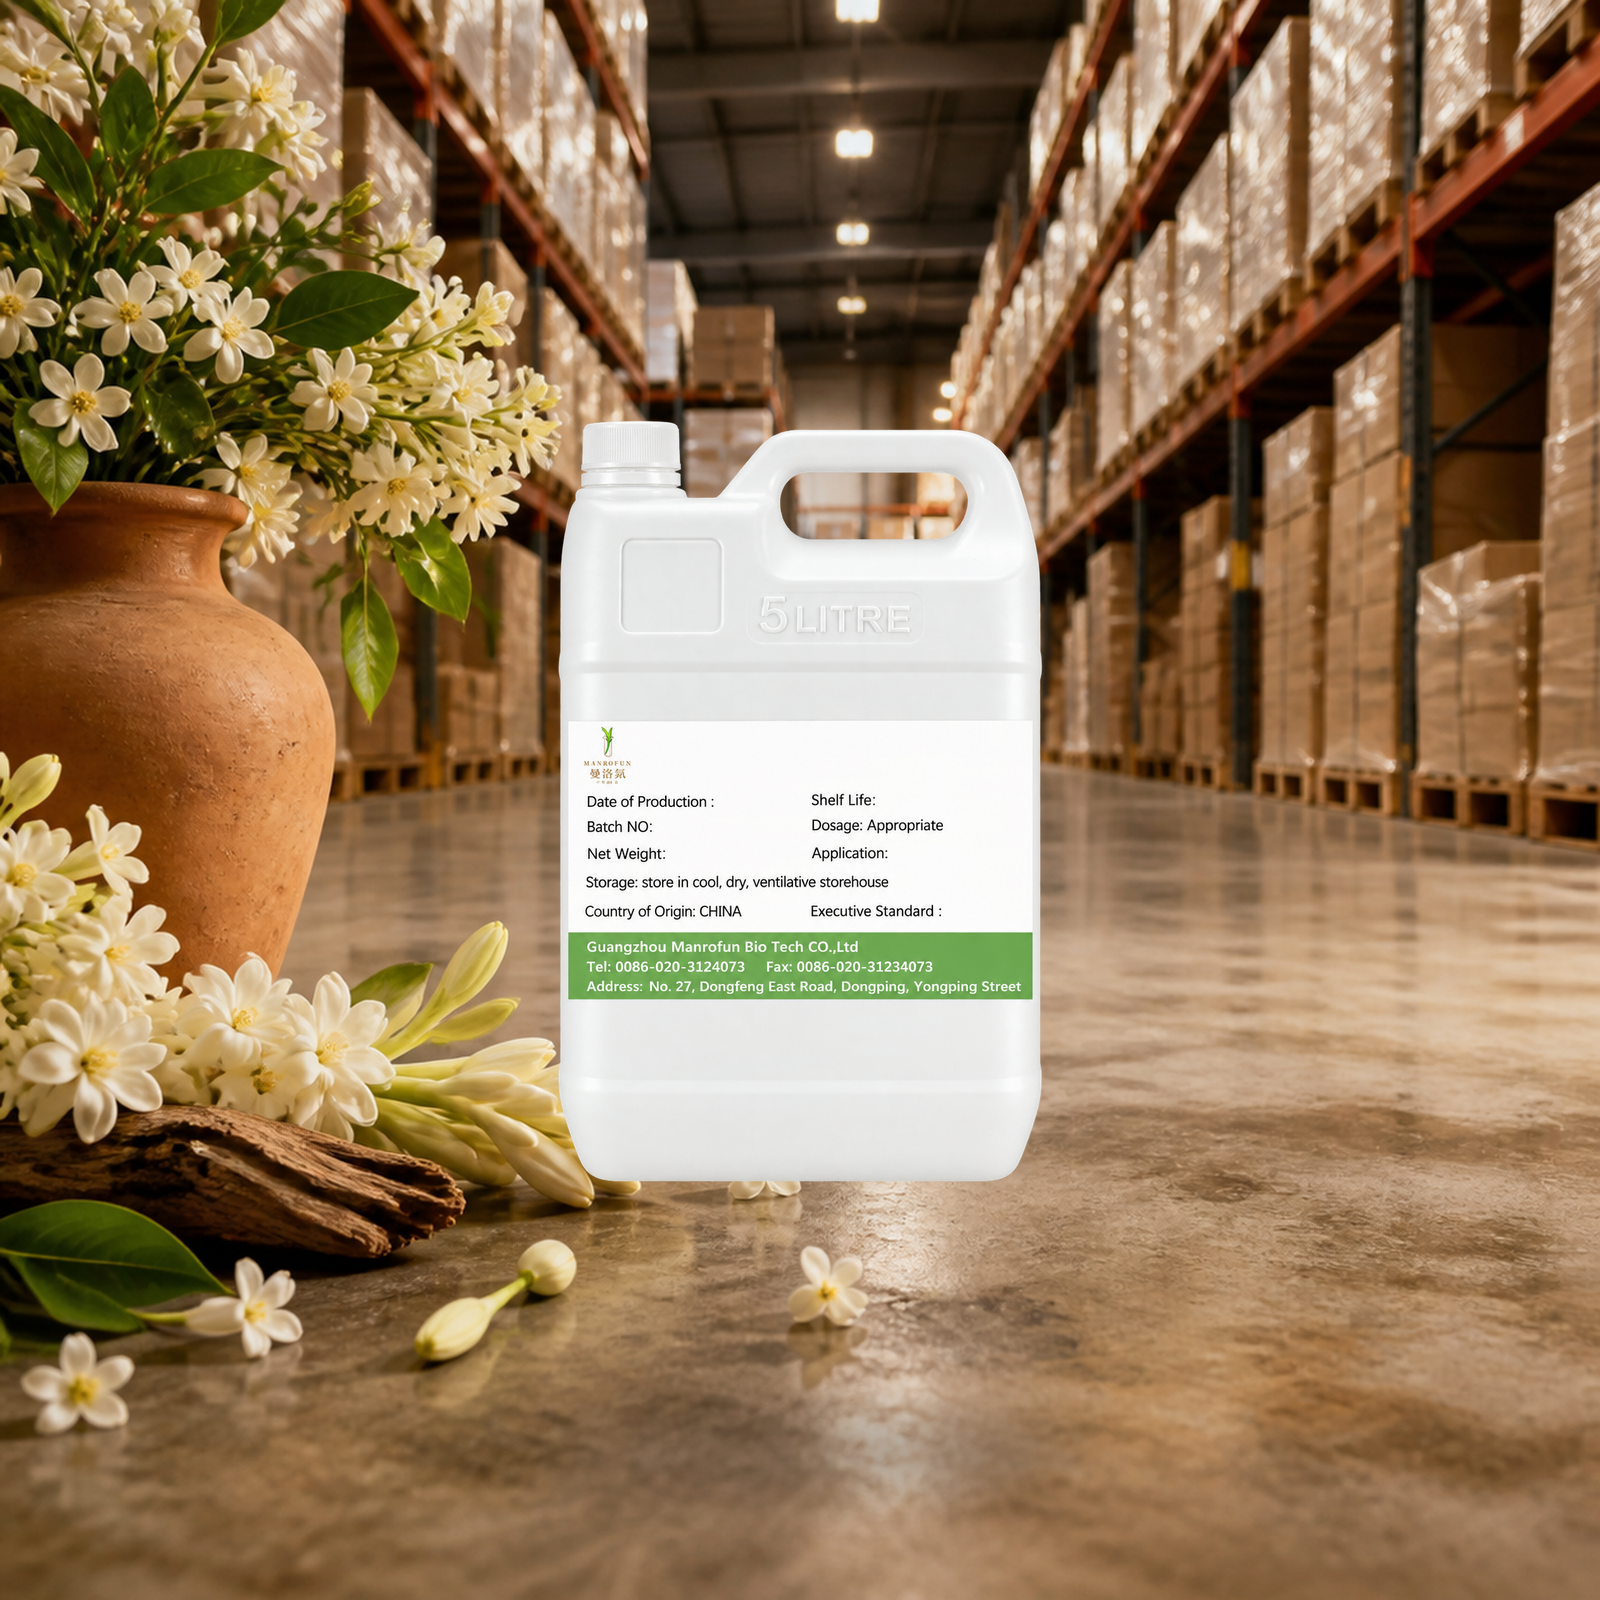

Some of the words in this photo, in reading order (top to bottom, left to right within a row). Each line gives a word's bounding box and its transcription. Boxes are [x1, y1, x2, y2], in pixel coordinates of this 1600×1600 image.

[759, 595, 788, 634] 5
[796, 605, 911, 633] LITRE
[587, 795, 618, 808] Date
[620, 794, 635, 808] of
[811, 793, 845, 806] Shelf
[848, 793, 876, 807] Life:
[587, 820, 623, 833] Batch
[627, 820, 653, 833] NO:
[811, 818, 863, 835] Dosage:
[866, 818, 944, 834] Appropriate
[587, 847, 612, 860] Net
[614, 847, 666, 863] Weight:
[811, 846, 888, 862] Application:
[585, 875, 638, 892] Storage:
[641, 877, 674, 889] store
[677, 875, 689, 888] in
[692, 875, 722, 890] cool,
[725, 875, 749, 891] dry,
[752, 875, 817, 888] ventilative
[819, 875, 889, 888] storehouse
[584, 905, 635, 921] Country
[638, 904, 652, 918] of
[654, 904, 696, 921] Origin:
[699, 905, 742, 918] CHINA
[811, 904, 872, 917] Executive
[586, 940, 667, 956] Guangzhou
[671, 940, 740, 953] Manrofun
[745, 940, 767, 953] Bio
[770, 940, 804, 953] Tech
[808, 940, 859, 955] CO.,Ltd
[586, 960, 611, 973] Tel:
[615, 960, 745, 973] 0086-020-3124073
[766, 960, 793, 973] Fax:
[796, 960, 933, 973] 0086-020-31234073
[586, 980, 643, 992] Address:
[649, 980, 672, 992] No.
[675, 980, 695, 994] 27,
[699, 980, 764, 995] Dongfeng
[768, 980, 796, 992] East
[799, 980, 837, 994] Road,
[841, 980, 910, 995] Dongping,
[913, 980, 978, 995] Yongping
[981, 980, 1022, 992] Street
